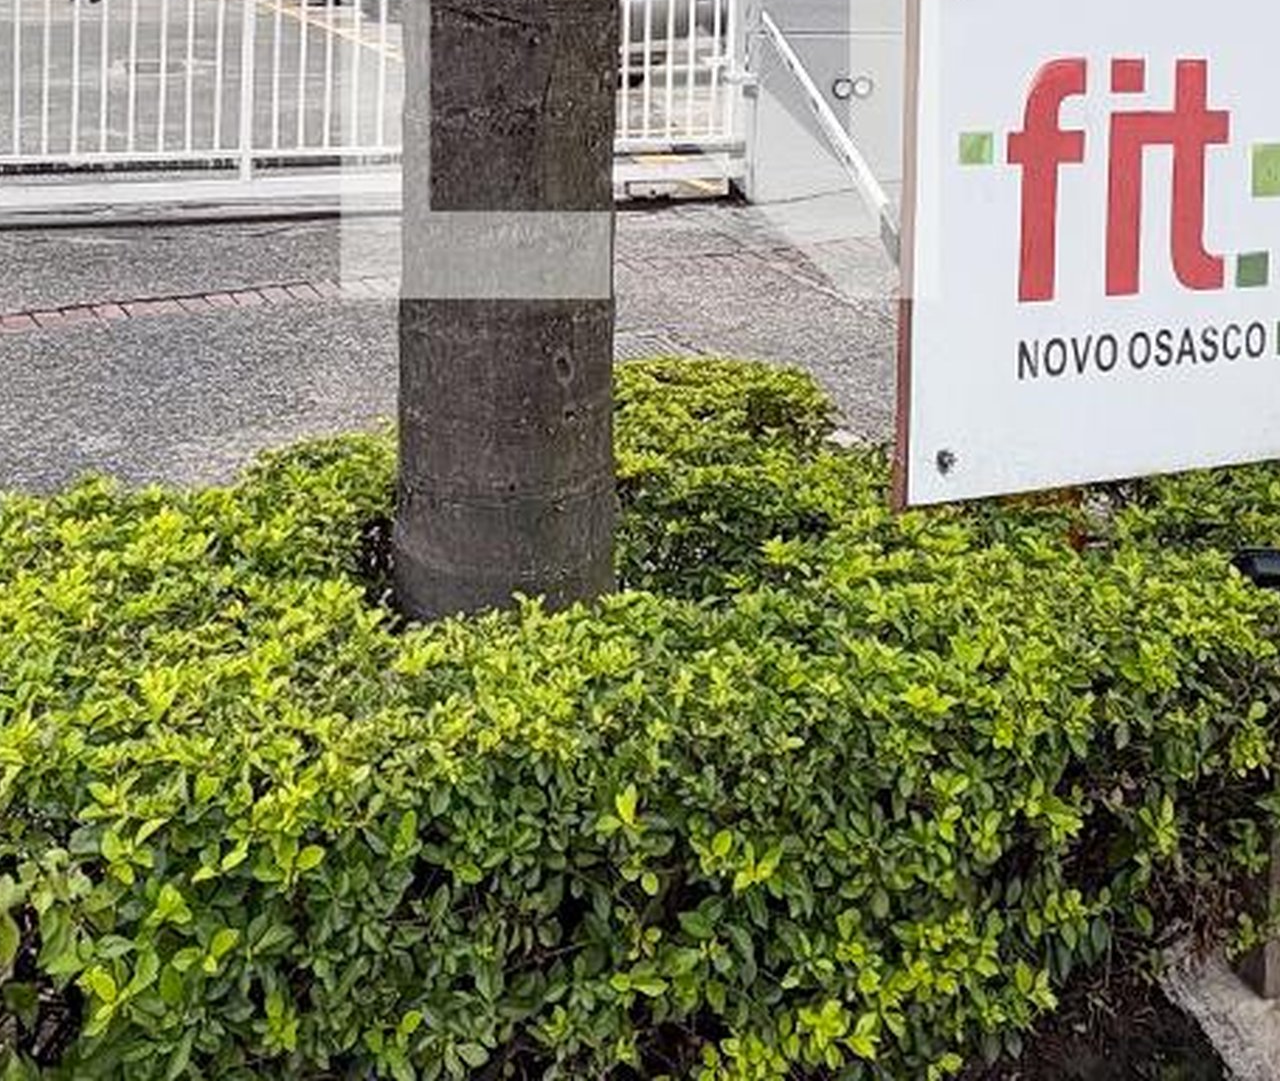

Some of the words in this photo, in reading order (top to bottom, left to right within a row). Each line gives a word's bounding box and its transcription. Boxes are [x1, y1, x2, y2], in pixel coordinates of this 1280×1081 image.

[1006, 57, 1230, 303] fit
[1017, 333, 1119, 381] NOVO
[1128, 321, 1268, 372] OSASCO
